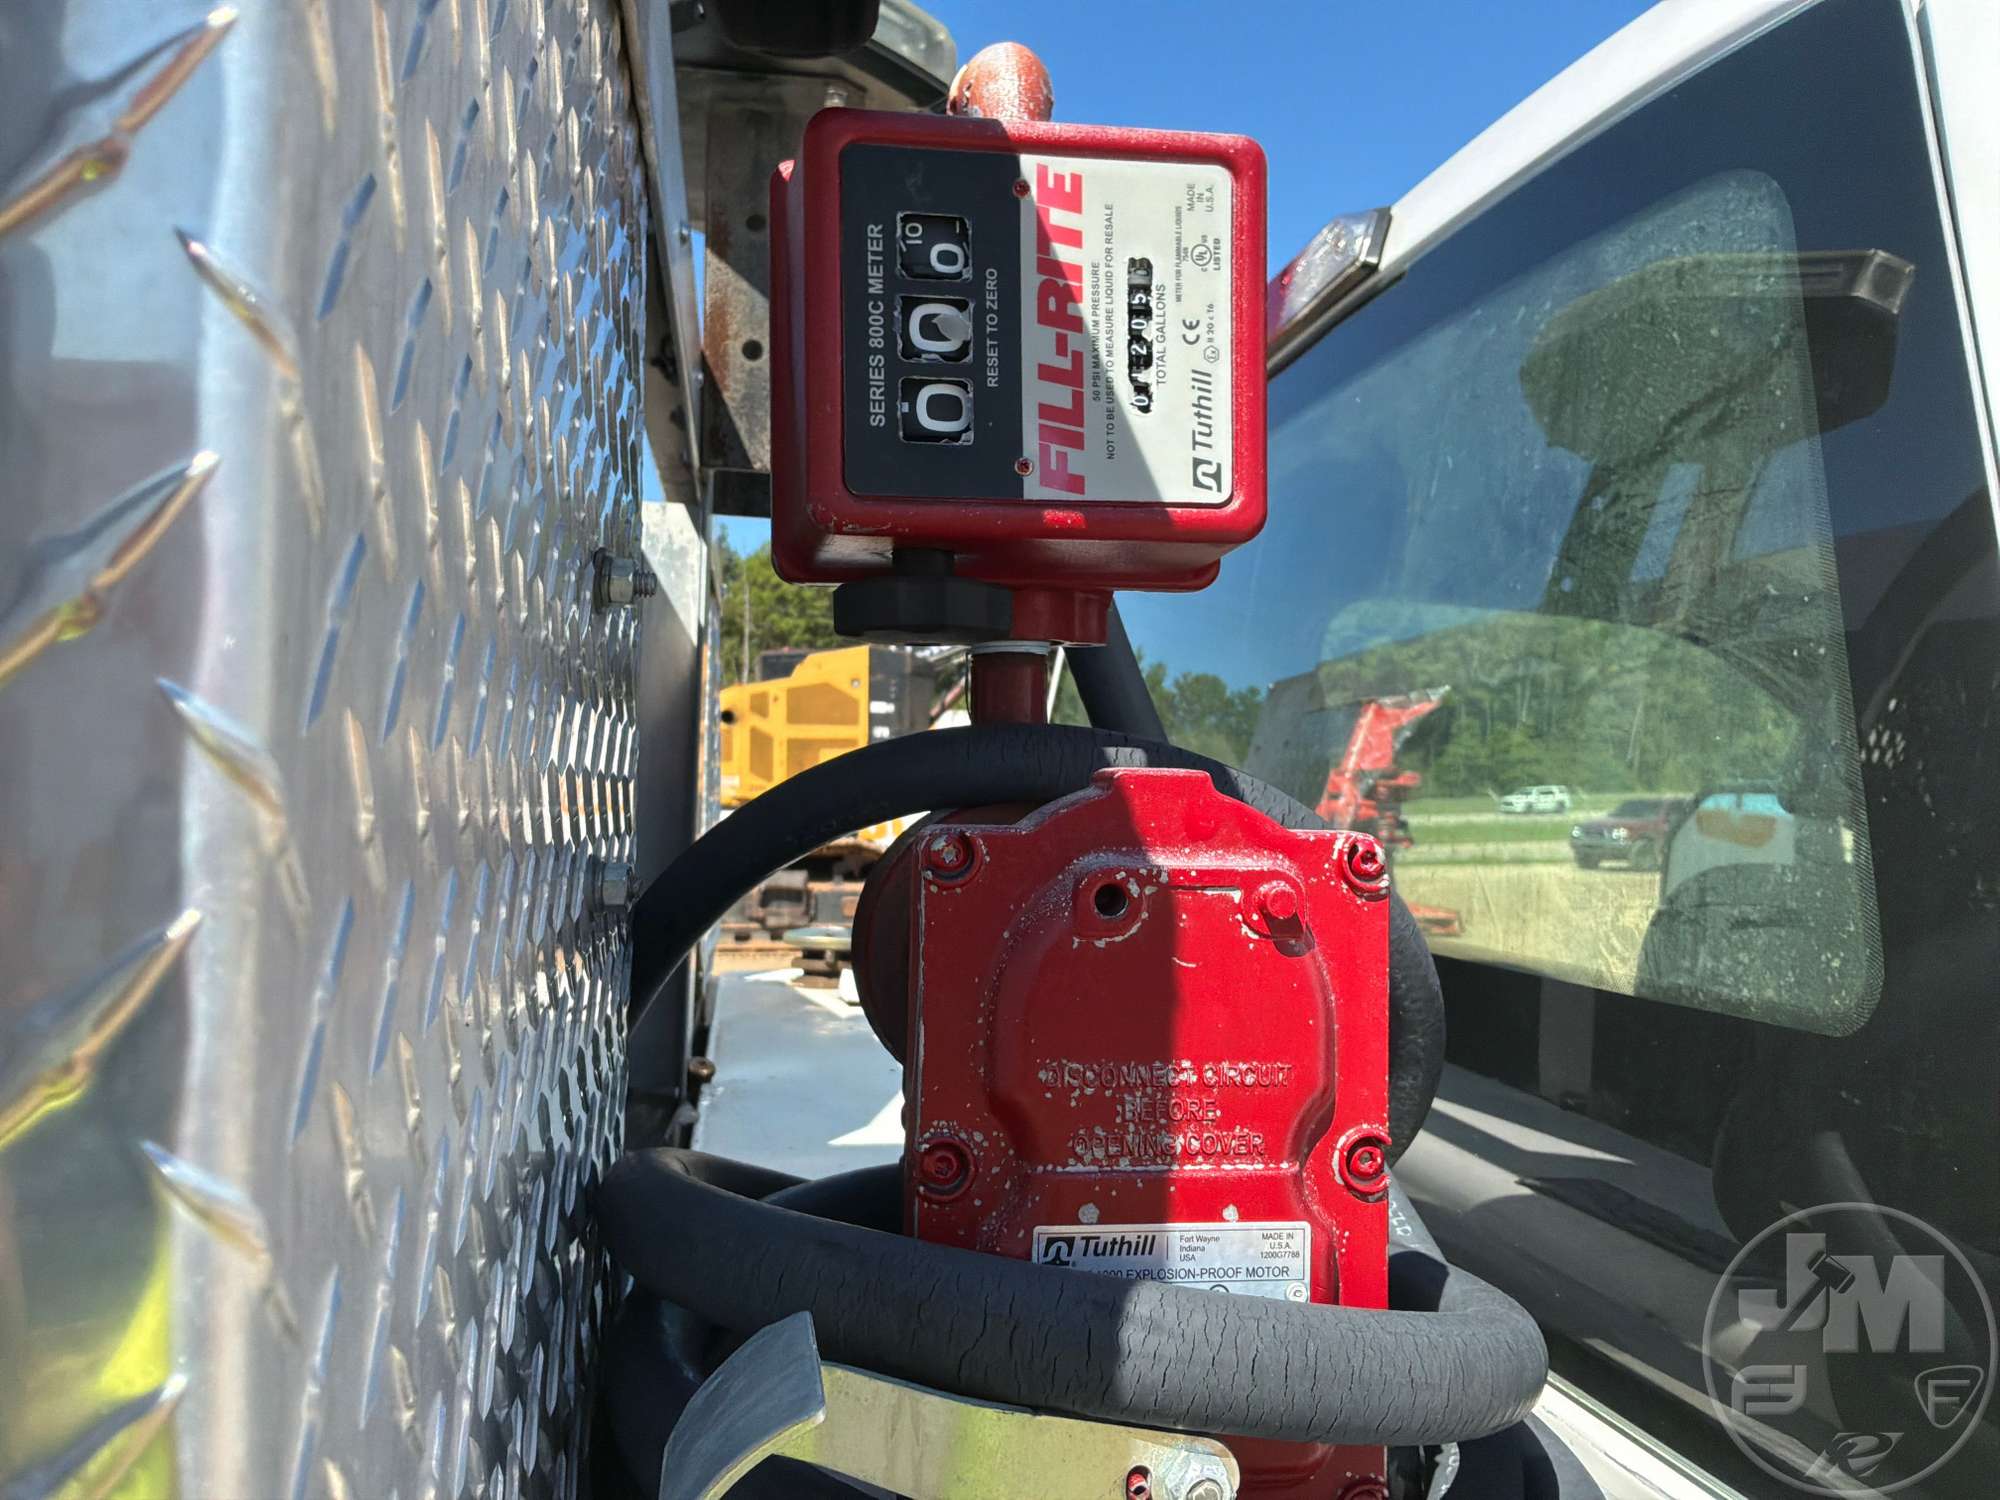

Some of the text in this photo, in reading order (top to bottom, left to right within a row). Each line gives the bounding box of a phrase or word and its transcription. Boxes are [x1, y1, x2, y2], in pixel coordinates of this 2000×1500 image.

[1186, 183, 1196, 212] MADE
[1196, 193, 1204, 203] IN
[1205, 184, 1215, 213] U.S.A.
[1175, 231, 1183, 268] FLAMMABLE
[1213, 238, 1221, 271] LISTED
[1175, 268, 1183, 281] FOR
[1175, 283, 1183, 303] METER
[867, 223, 886, 428] SERIES 800C METER
[985, 268, 1000, 388] RESET TO ZERO
[1035, 162, 1086, 496] FILL-RITE
[1090, 261, 1101, 402] 50 PSI MAXIMUM PRESSURE
[1103, 203, 1116, 460] NOT TO BE USED TO MEASURE LIQUID FOR RESALE
[1155, 283, 1167, 386] TOTAL GALLONS
[1191, 368, 1213, 451] Tuthill
[1046, 1063, 1292, 1088] DISCONNECT CIRCUIT
[1124, 1097, 1216, 1121] BEFORE
[1073, 1131, 1265, 1157] OPENING COVER
[1080, 1234, 1157, 1257] Tuthill
[1179, 1234, 1221, 1245] Fort Wayne
[1179, 1245, 1206, 1253] Indiana
[1261, 1232, 1294, 1241] MADE IN
[1269, 1241, 1292, 1250] U.S.A.
[1179, 1253, 1197, 1261] USA
[1126, 1266, 1242, 1281] EXPLOSION-PROOF
[1245, 1265, 1290, 1279] MOTOR
